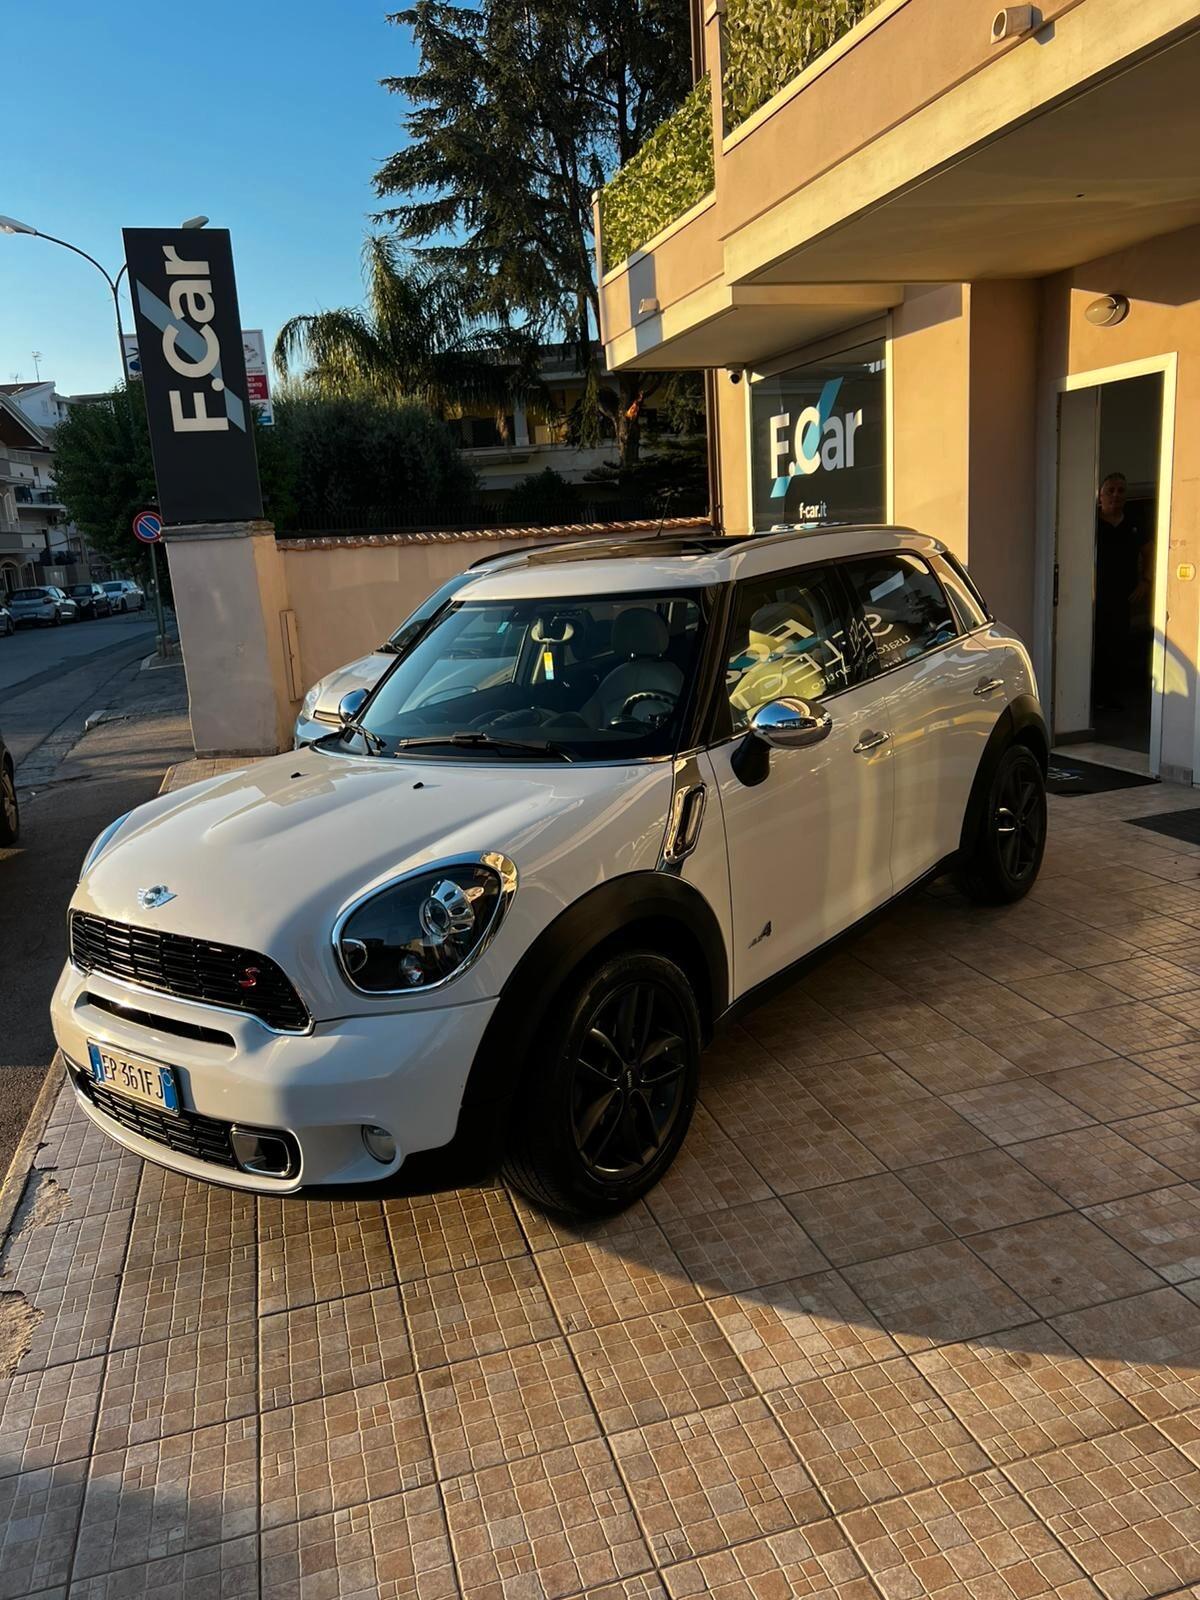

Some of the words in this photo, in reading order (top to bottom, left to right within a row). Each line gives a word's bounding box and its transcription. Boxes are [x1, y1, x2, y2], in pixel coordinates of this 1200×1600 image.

[162, 245, 229, 433] F.Car
[769, 406, 863, 479] F.Car
[799, 501, 827, 519] f-car.it
